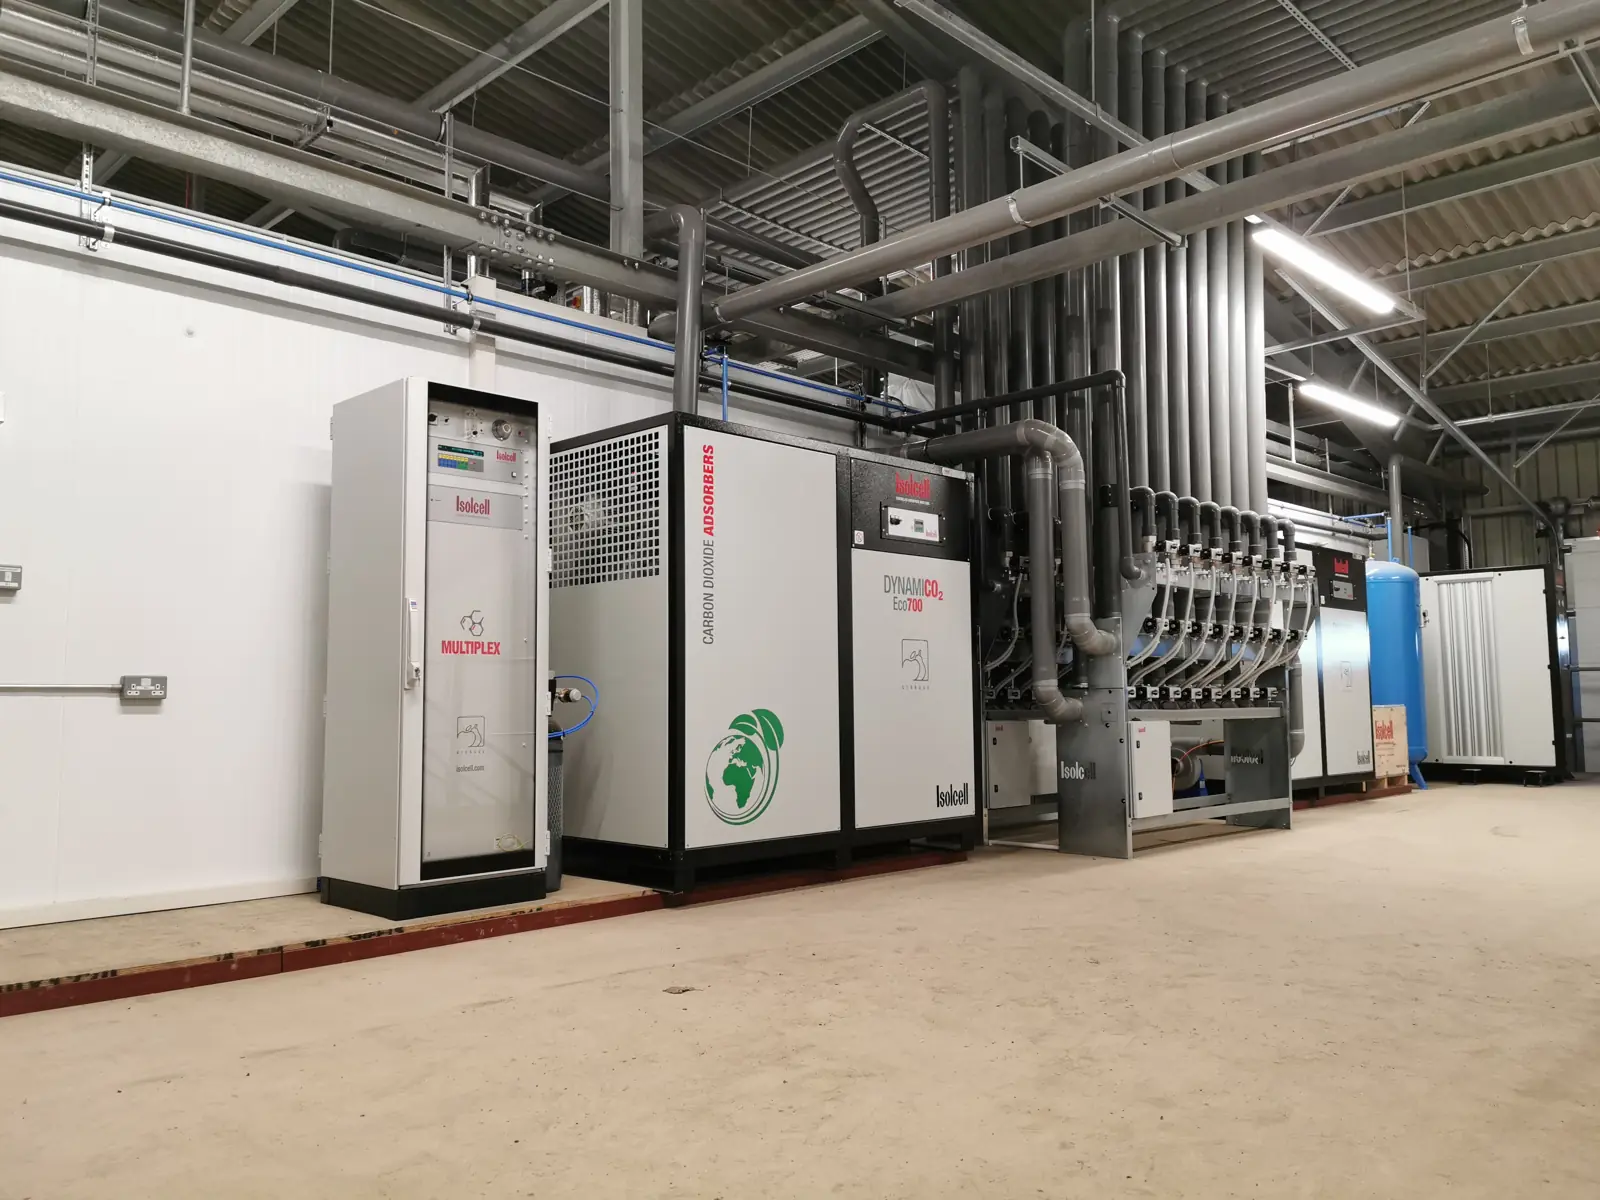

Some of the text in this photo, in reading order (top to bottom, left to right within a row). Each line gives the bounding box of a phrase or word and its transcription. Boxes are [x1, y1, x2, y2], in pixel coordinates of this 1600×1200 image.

[895, 472, 931, 500] Isolcell
[456, 495, 490, 515] Isolcell
[703, 444, 714, 645] CARBON DIOXIDE ADSORBERS
[893, 597, 923, 612] Eco700
[441, 640, 501, 656] MULTIPLEX
[936, 782, 969, 808] Isolcell
